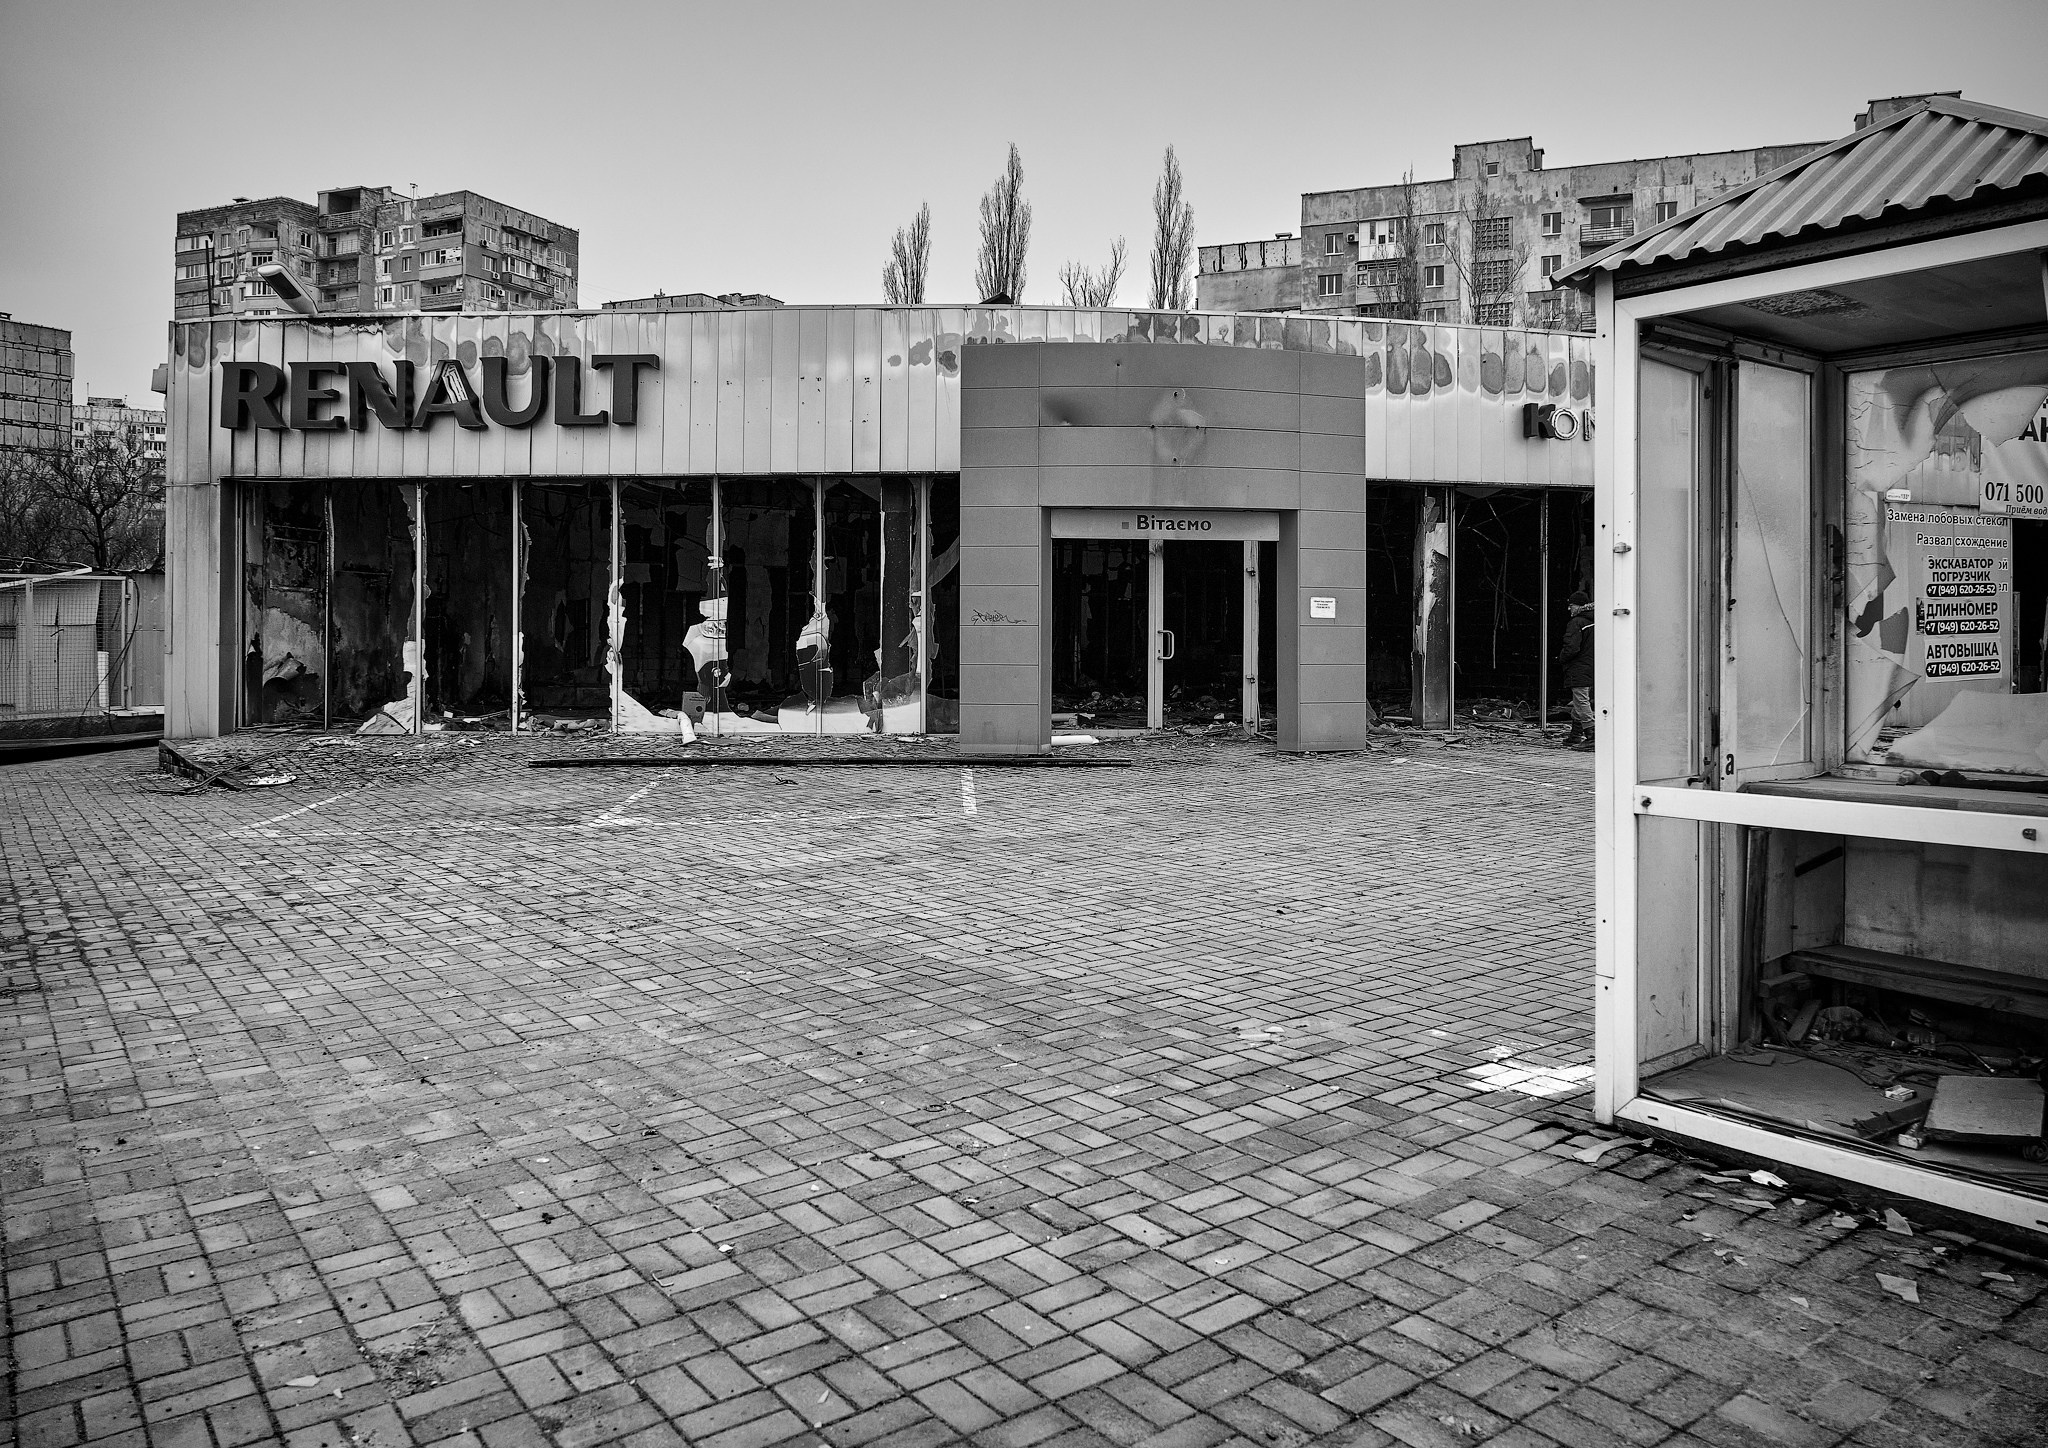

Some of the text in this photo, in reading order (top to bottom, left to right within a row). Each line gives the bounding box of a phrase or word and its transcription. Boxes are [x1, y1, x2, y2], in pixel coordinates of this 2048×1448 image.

[219, 354, 660, 430] RENAULT
[1985, 482, 2044, 504] 071 500
[1887, 508, 2009, 527] Замена лобовых стекол
[2006, 505, 2032, 516] Приём
[1136, 514, 1212, 531] Вітаємо
[1916, 533, 2008, 549] Развал схождение
[1928, 558, 1994, 570] ЭКСКАВАТОР
[1932, 571, 1991, 582] ПОГРУЗЧИК
[1927, 584, 1996, 596] +7 (949) 620-26-52
[1926, 602, 1998, 619] ДЛИННОМЕР
[1925, 620, 1999, 634] +7 (949) 620-26-52
[1926, 642, 1999, 659] АВТОВЫШКА
[1926, 661, 2000, 675] +7 (949) 620-26-52
